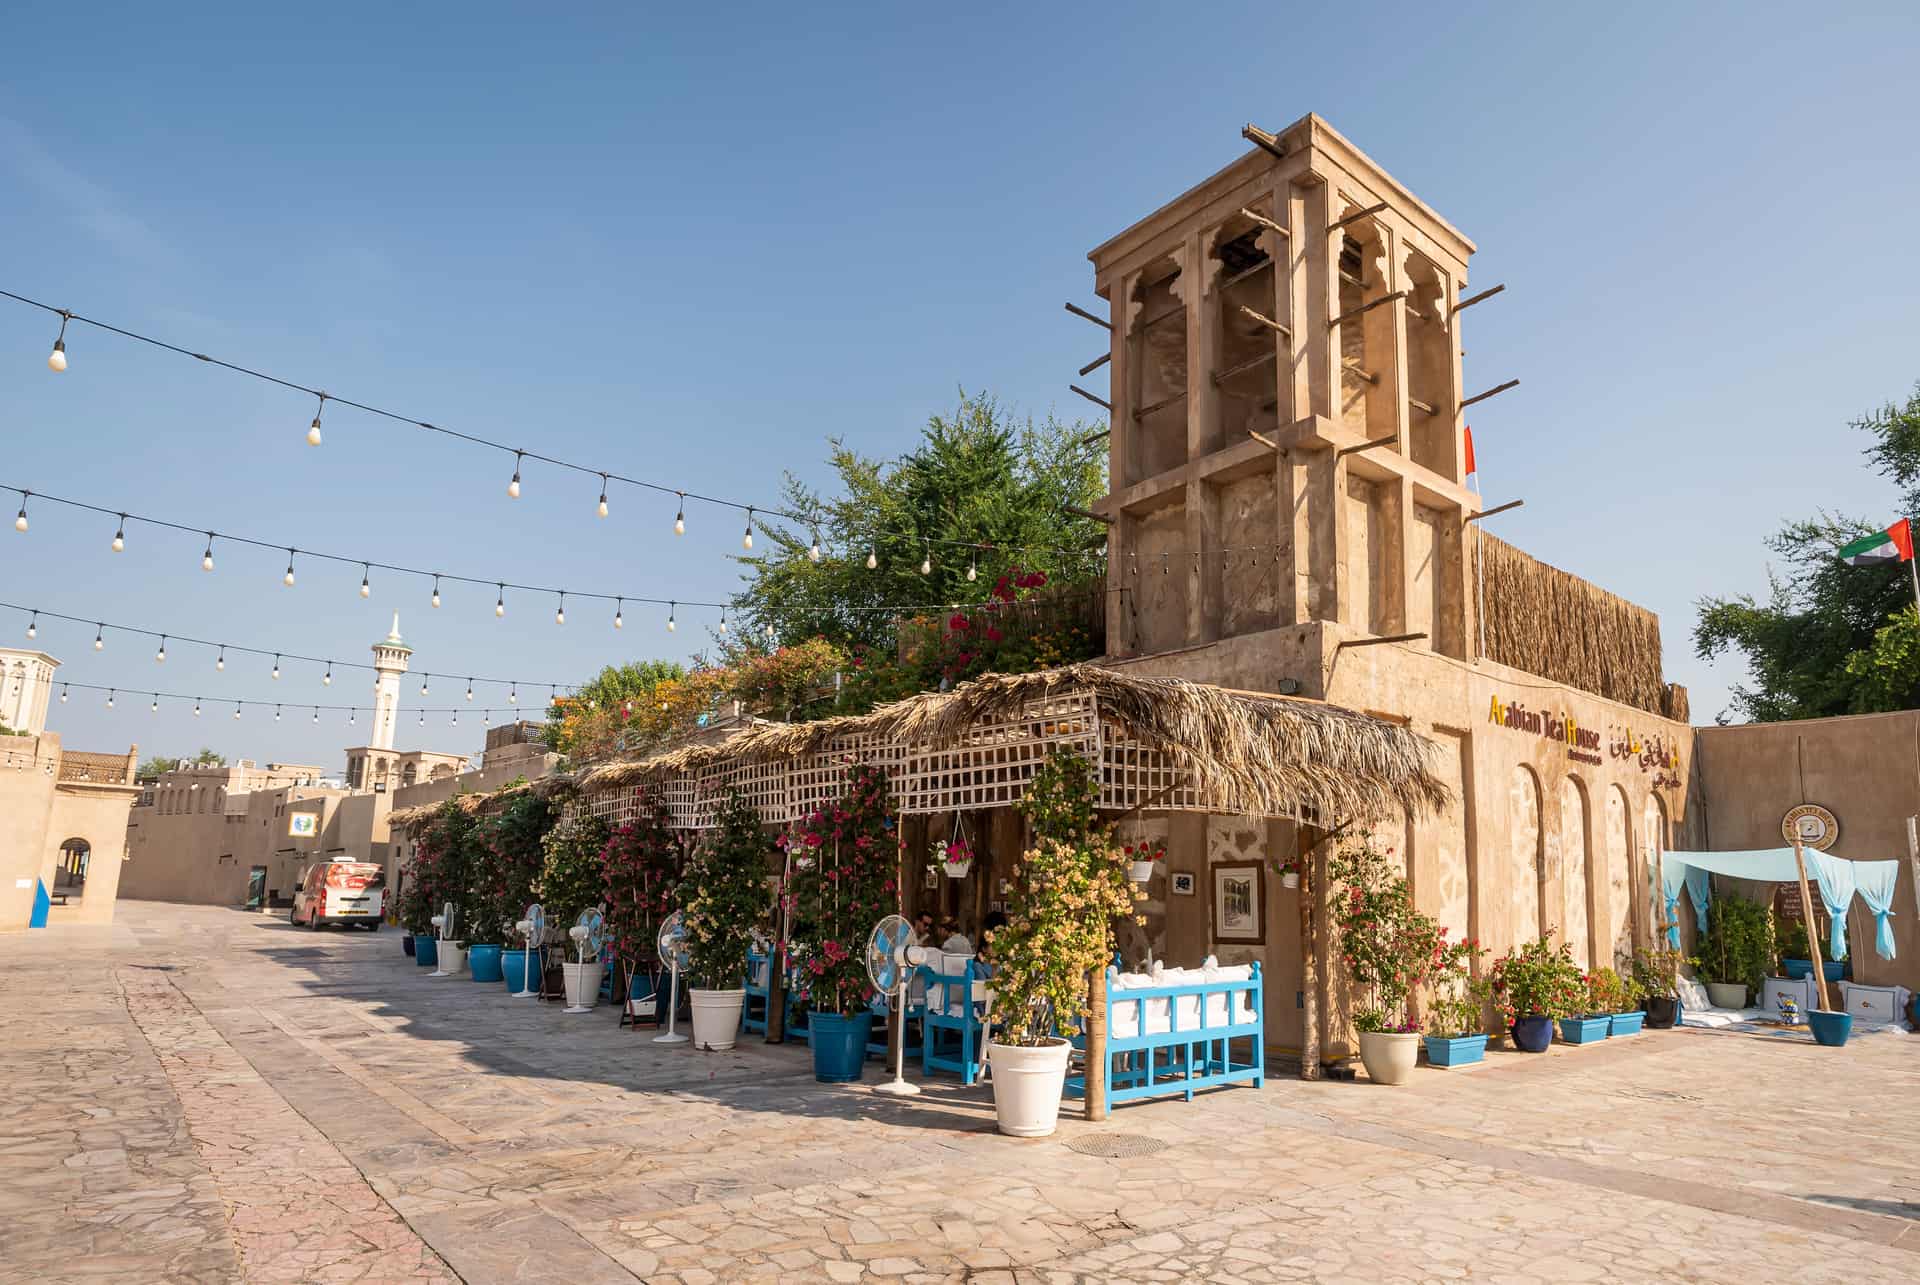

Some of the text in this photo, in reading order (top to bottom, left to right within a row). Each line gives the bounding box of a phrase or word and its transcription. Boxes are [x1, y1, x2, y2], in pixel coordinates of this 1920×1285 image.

[1488, 694, 1600, 751] Arabian Tea House
